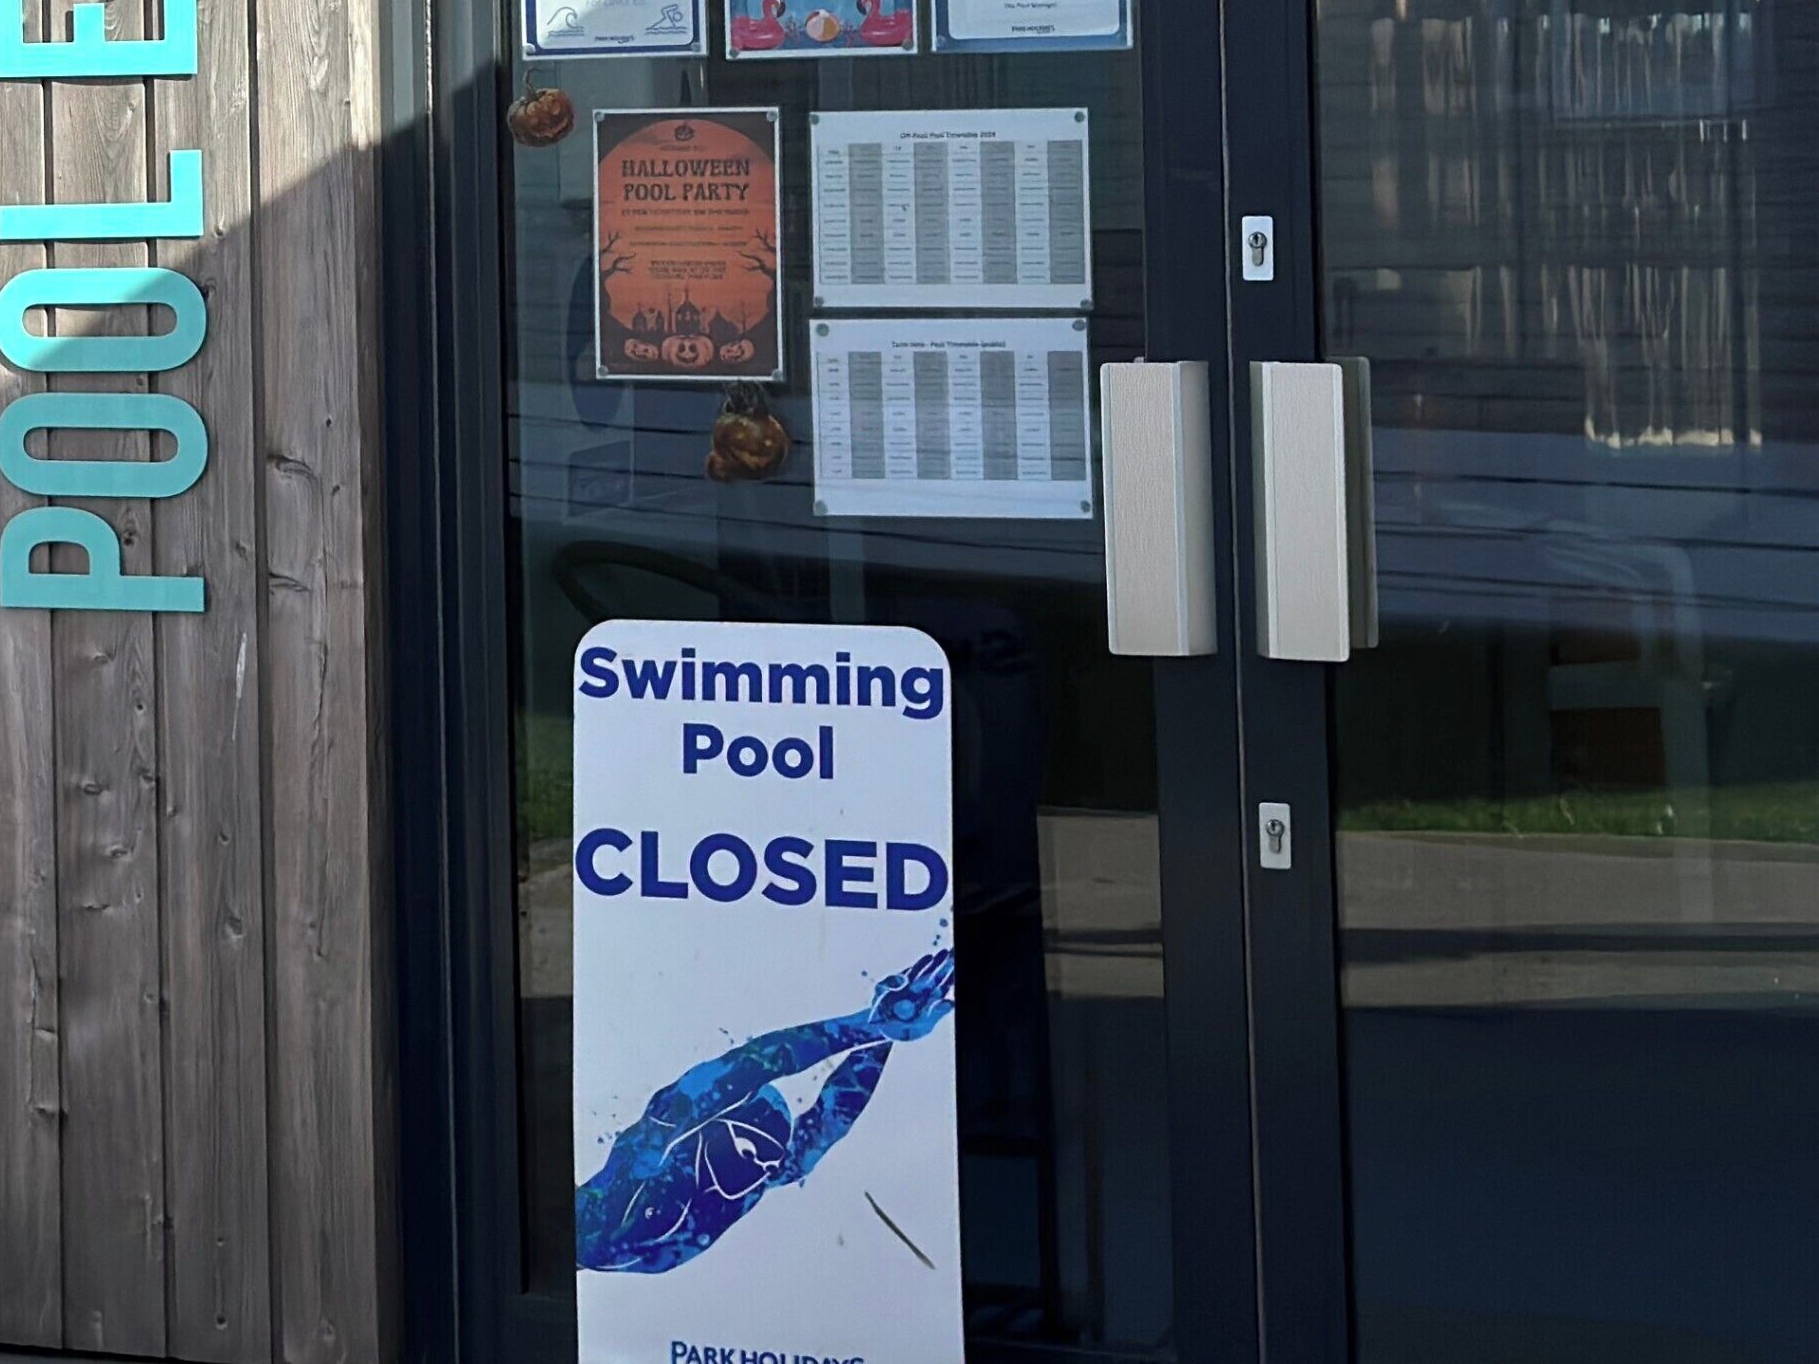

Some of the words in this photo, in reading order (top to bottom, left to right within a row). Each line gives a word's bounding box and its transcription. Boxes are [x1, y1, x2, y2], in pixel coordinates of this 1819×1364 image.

[622, 158, 750, 177] HALLOWEEN
[624, 183, 677, 201] POOL
[682, 182, 750, 201] PARTY
[578, 646, 944, 720] Swimming
[682, 723, 834, 780] Pool
[575, 828, 949, 912] CLOSED
